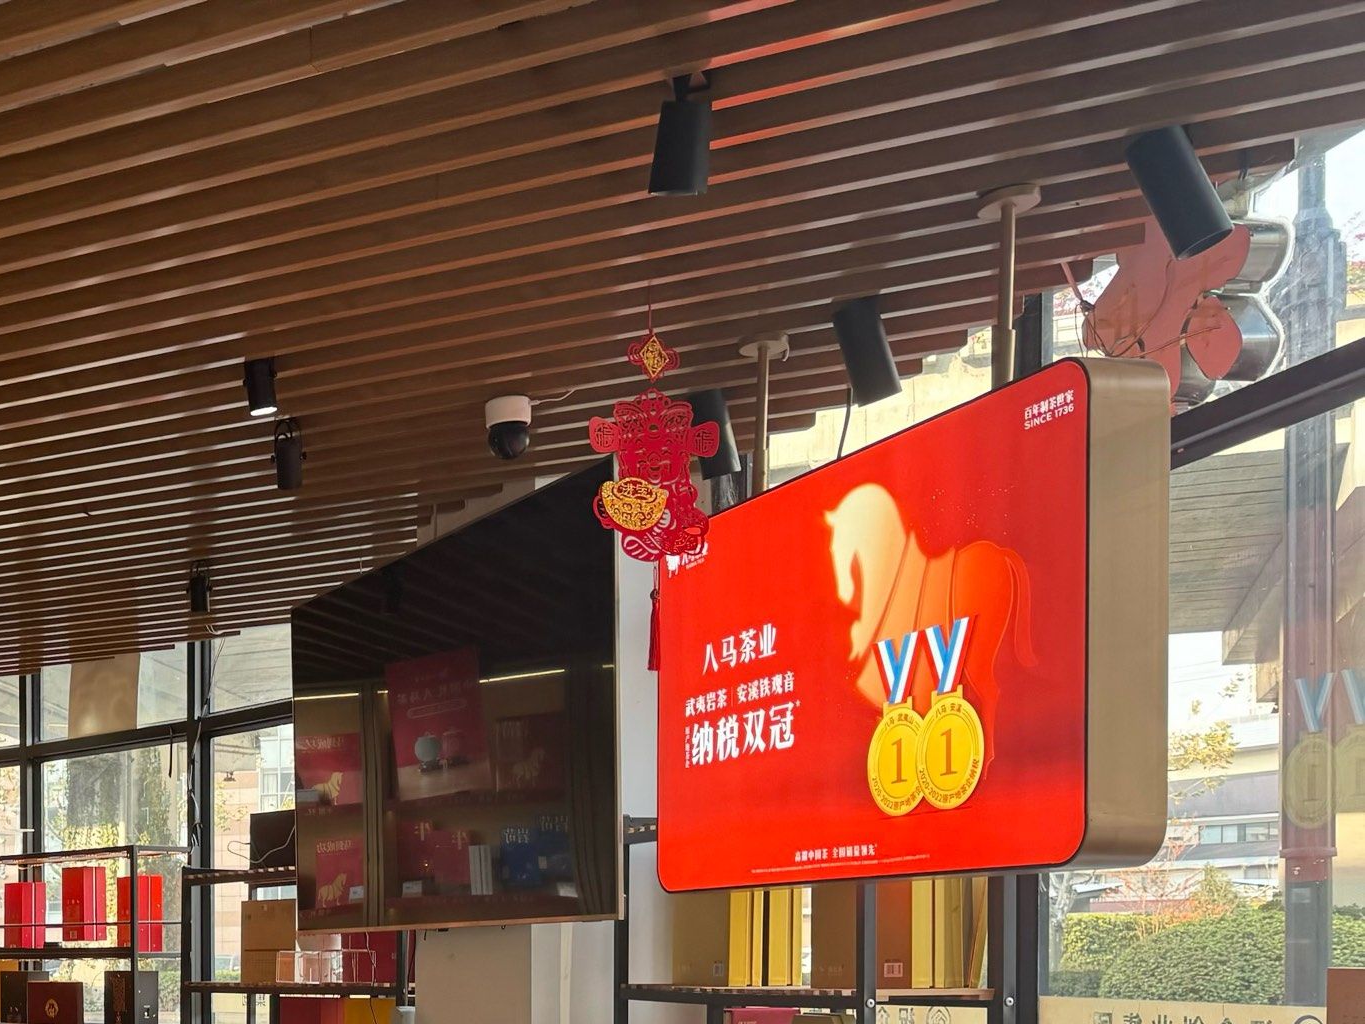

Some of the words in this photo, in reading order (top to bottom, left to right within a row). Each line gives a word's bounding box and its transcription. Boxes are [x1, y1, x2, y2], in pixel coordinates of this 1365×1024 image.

[1024, 411, 1052, 430] SINCE
[1055, 403, 1074, 418] 1736
[702, 623, 777, 676] 八马茶业
[685, 688, 728, 718] 武夷岩茶
[737, 671, 795, 704] 安溪铁观音
[691, 702, 795, 766] 纳税双冠
[940, 728, 958, 777] 1
[891, 737, 908, 784] 1
